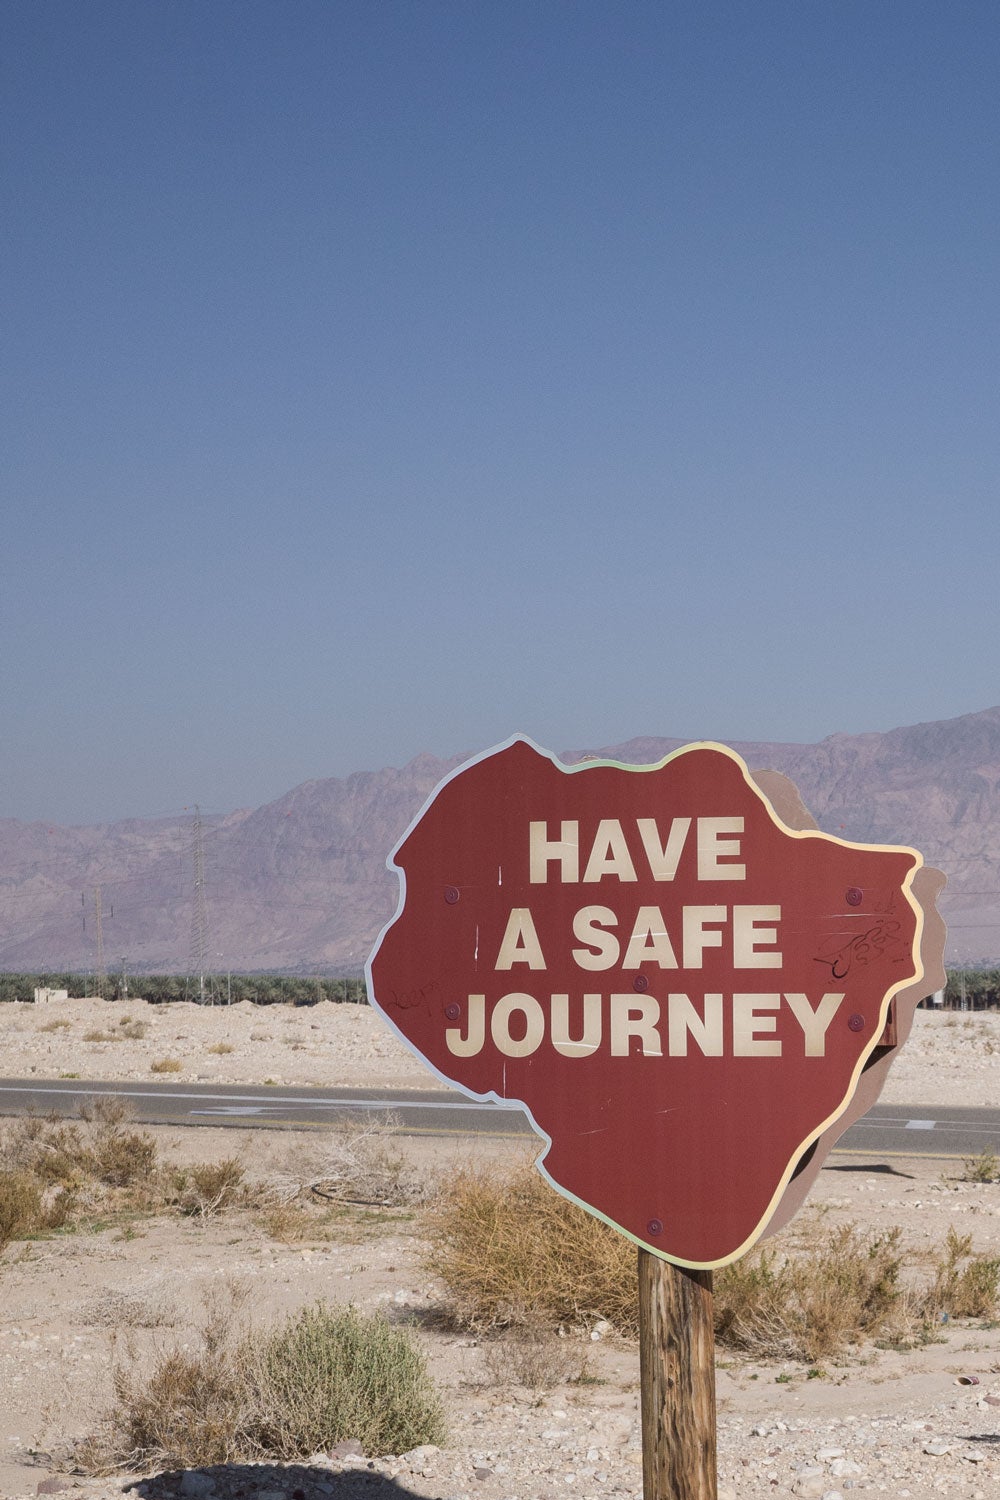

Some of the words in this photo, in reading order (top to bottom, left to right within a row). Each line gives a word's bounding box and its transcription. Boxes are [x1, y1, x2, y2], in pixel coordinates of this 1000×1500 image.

[529, 817, 746, 883] HAVE
[494, 908, 547, 971] A
[572, 904, 783, 971] SAFE
[445, 993, 845, 1058] JOURNEY
